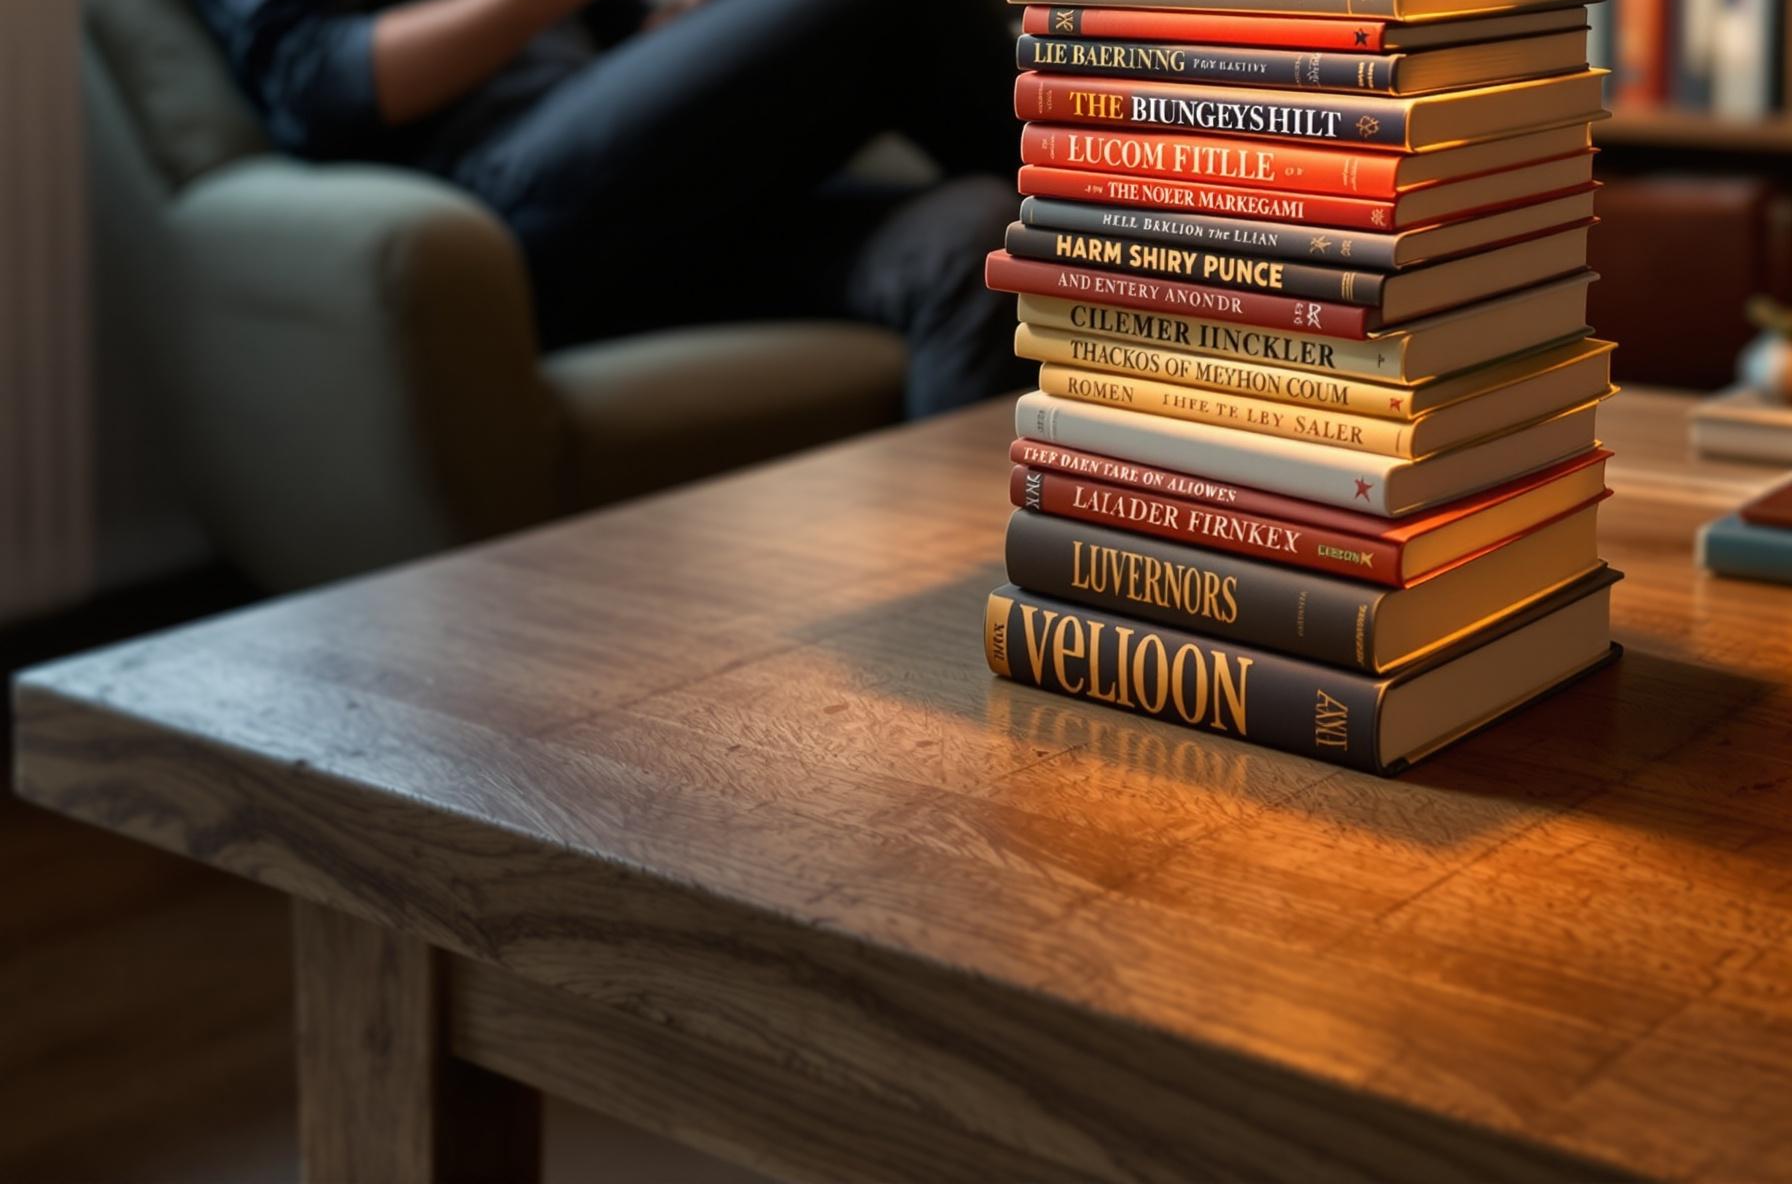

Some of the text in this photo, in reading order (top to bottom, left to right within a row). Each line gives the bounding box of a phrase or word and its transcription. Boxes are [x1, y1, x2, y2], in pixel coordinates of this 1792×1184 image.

[1033, 42, 1067, 64] LIE
[1069, 91, 1124, 119] THE
[1173, 143, 1275, 182] FITLLE
[1107, 181, 1140, 201] THE
[1198, 191, 1305, 219] MARKEGAMI
[1056, 234, 1284, 289] HARM SHIRY PUNCE
[1057, 272, 1244, 314] AND ENTERY ANONDR
[1070, 304, 1191, 346] CILEMER
[1068, 376, 1135, 404] ROMEN
[1070, 339, 1350, 406] THACKOS OF MEYHON COUM
[1294, 415, 1364, 445] SALER
[1072, 541, 1238, 624] LUVERNORS
